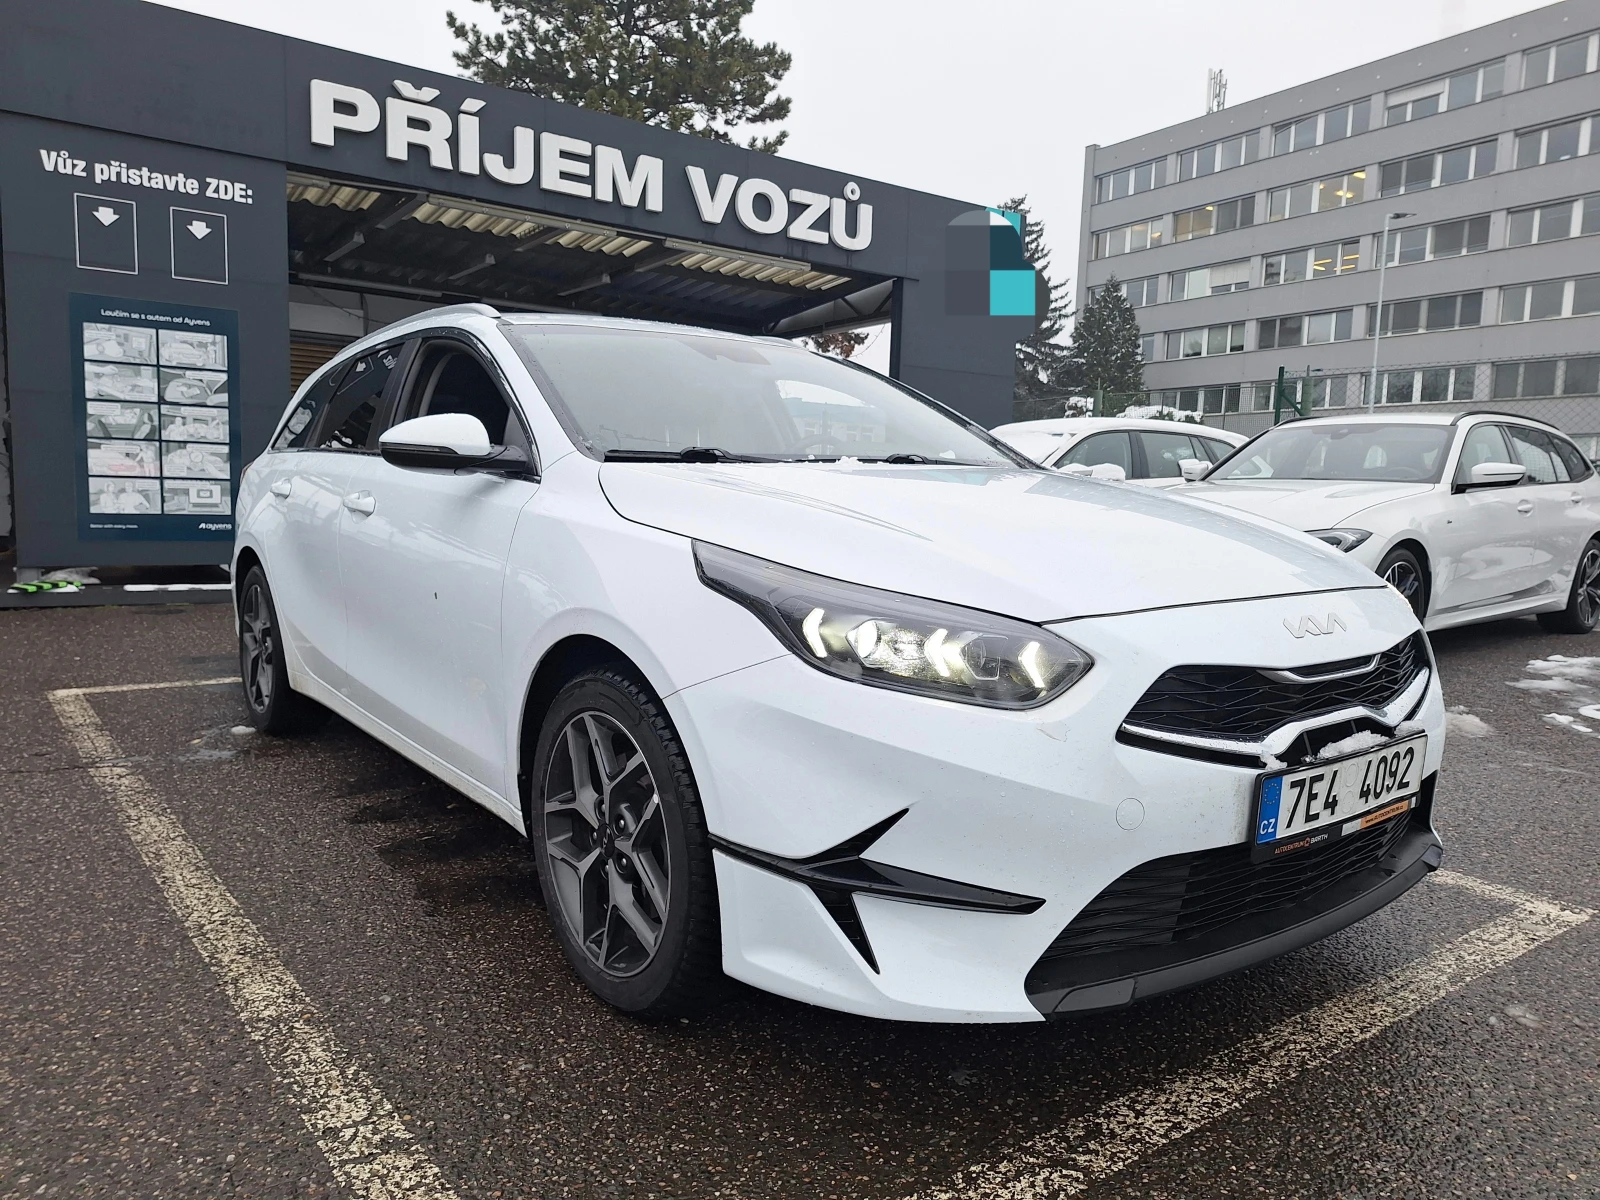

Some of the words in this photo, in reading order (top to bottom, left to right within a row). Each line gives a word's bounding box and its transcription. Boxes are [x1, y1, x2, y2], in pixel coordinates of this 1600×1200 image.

[39, 149, 87, 177] Vůz
[94, 160, 200, 195] přistavte
[205, 177, 253, 204] ZDE:
[310, 78, 664, 213] PŘÍJEM
[684, 165, 873, 251] VOZŮ
[146, 314, 171, 322] autem
[183, 317, 211, 326] Ayvens
[1285, 769, 1339, 830] 7E4
[1359, 747, 1415, 804] 4092
[1259, 818, 1276, 835] CZ
[1310, 833, 1329, 844] BARTH
